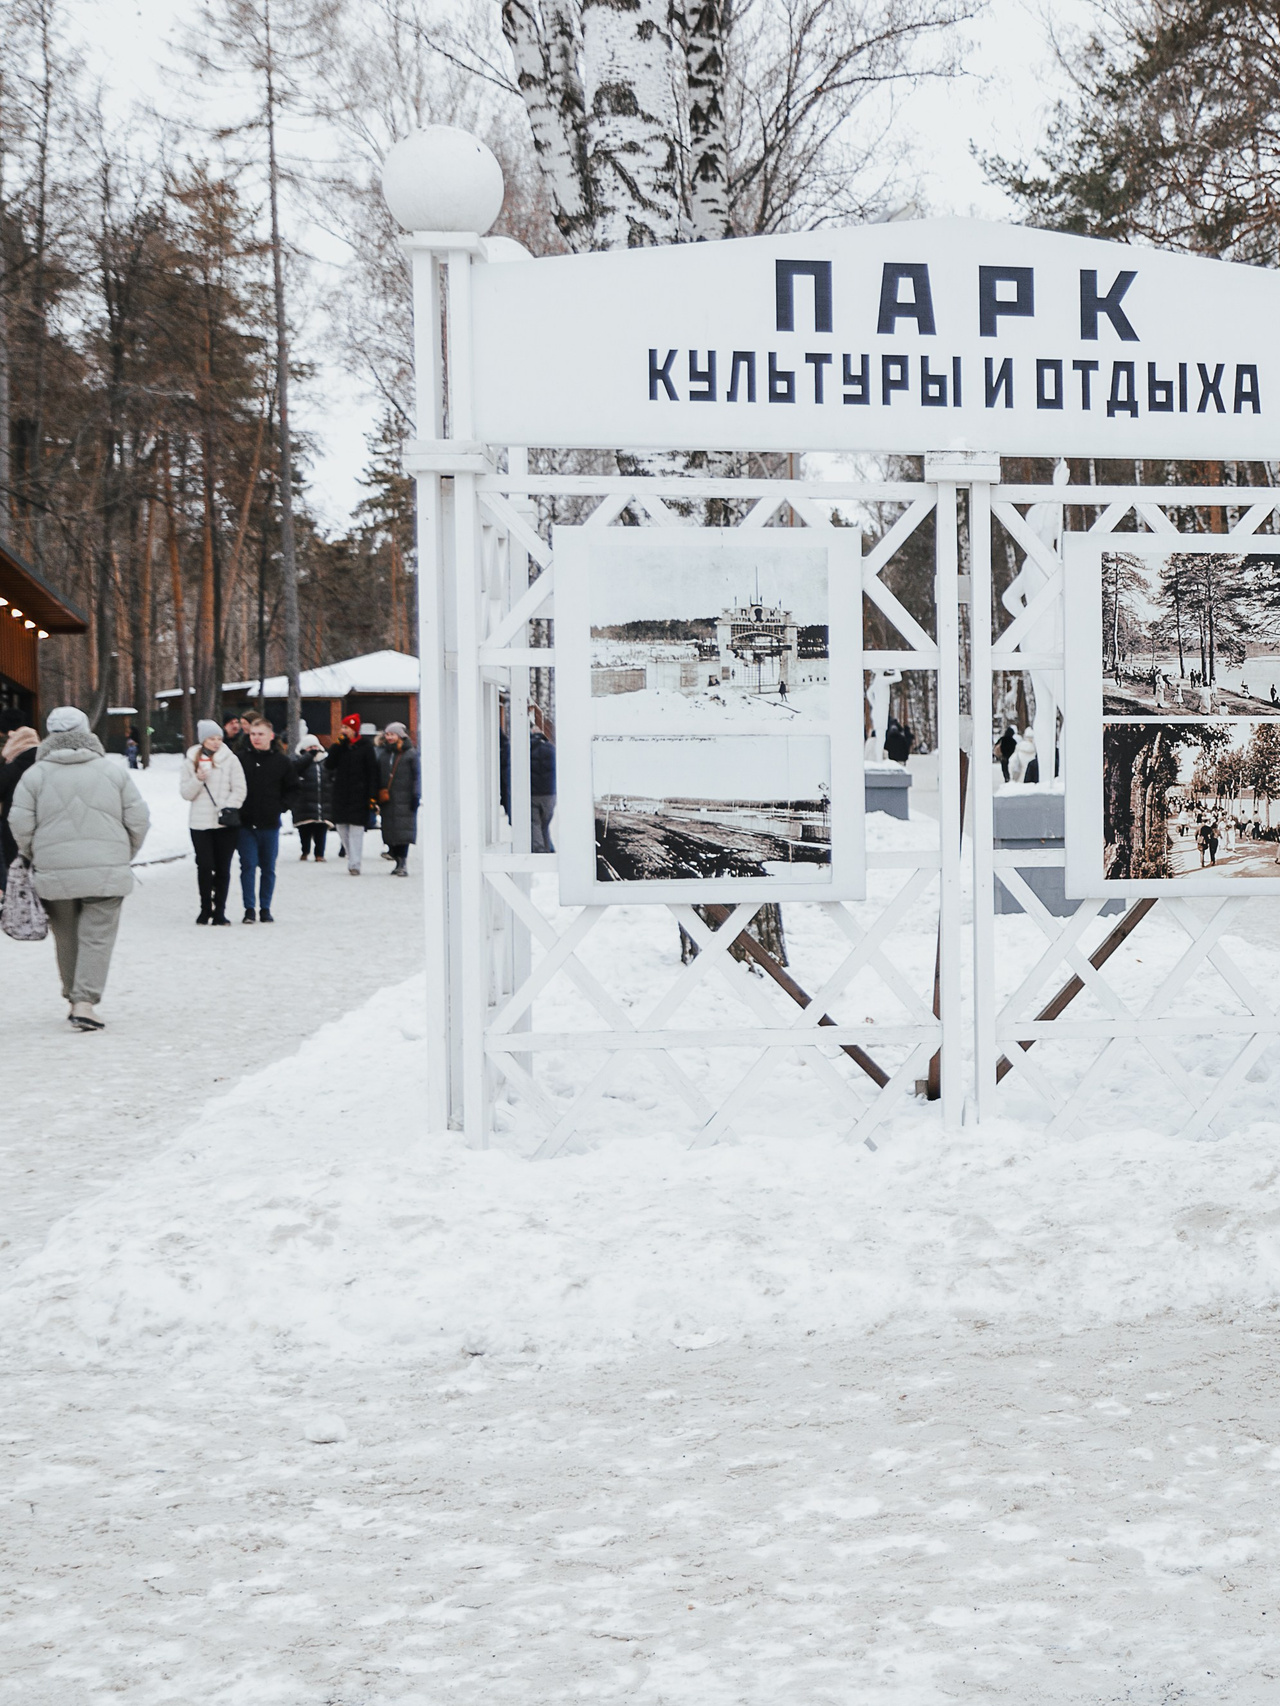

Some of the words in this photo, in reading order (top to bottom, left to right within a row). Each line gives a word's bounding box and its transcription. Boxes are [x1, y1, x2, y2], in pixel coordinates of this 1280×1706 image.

[775, 258, 1141, 342] ПАРК
[648, 348, 962, 408] КУЛЬТУРЫ
[984, 356, 1014, 409] И
[1035, 358, 1262, 419] ОТДЫХА
